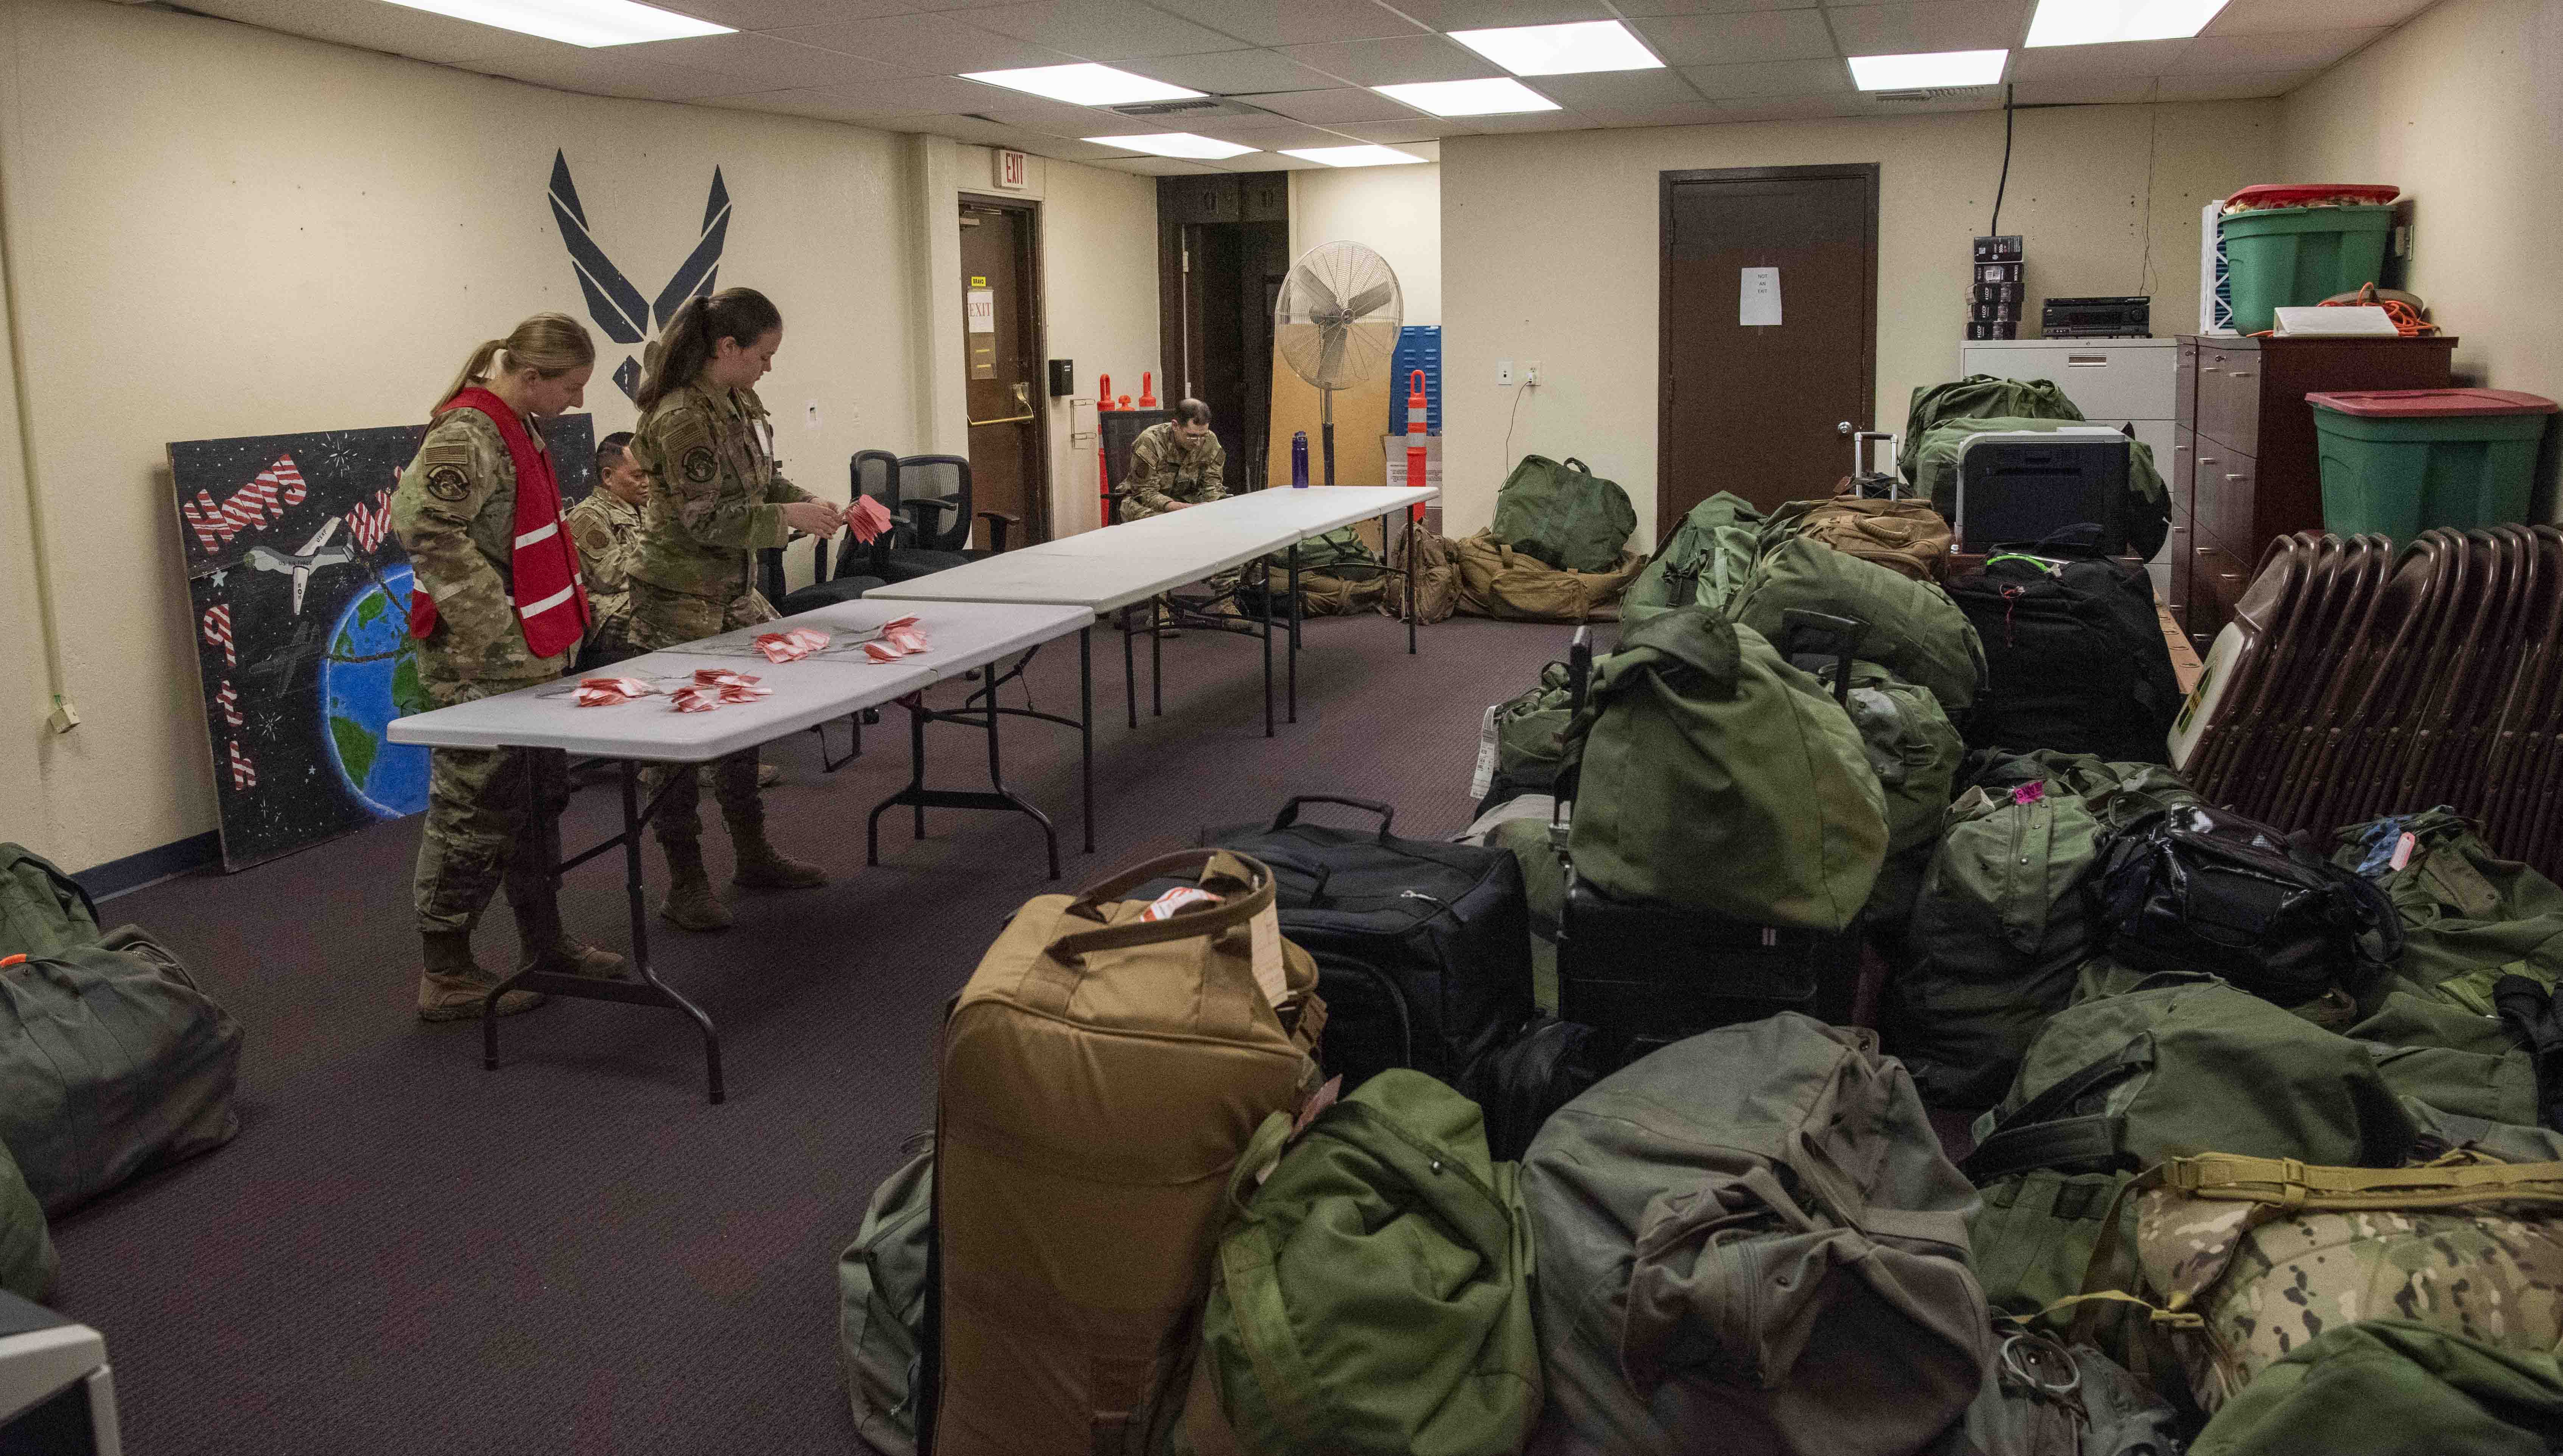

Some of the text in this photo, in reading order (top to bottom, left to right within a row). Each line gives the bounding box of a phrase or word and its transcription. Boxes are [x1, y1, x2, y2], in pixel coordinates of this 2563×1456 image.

[1006, 153, 1023, 185] EXIT
[968, 303, 991, 317] EXIT
[316, 529, 327, 543] USAF
